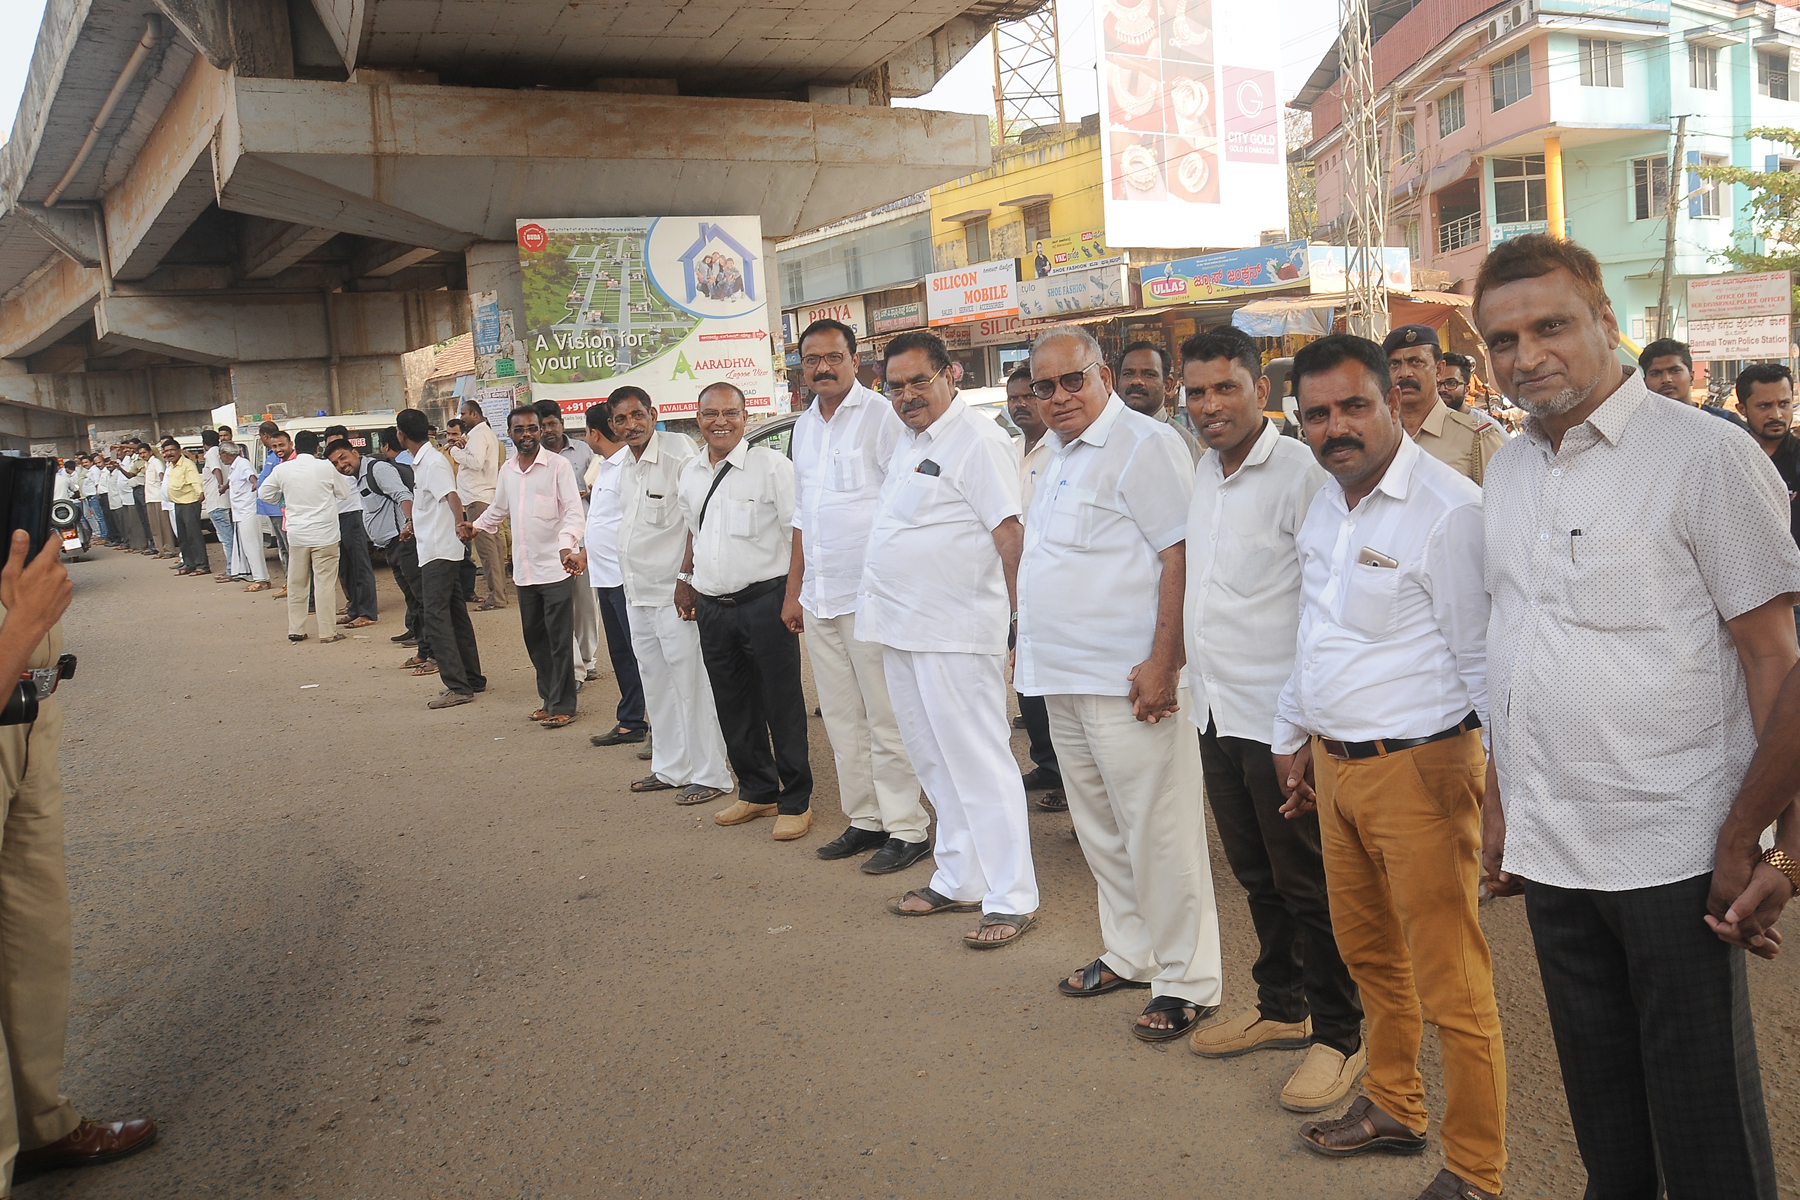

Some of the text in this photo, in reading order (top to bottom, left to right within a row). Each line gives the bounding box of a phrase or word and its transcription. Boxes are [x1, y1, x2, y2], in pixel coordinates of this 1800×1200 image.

[1228, 131, 1276, 145] CITY GOLD
[1229, 145, 1243, 153] GOLD
[1066, 264, 1087, 272] FASHION
[933, 271, 978, 292] SILICON
[1021, 283, 1036, 294] tylo
[1153, 279, 1186, 295] ULLAS
[964, 284, 1009, 305] MOBILE
[1047, 283, 1087, 297] SHOE FASHION
[808, 304, 851, 324] PRIYA
[535, 330, 646, 351] A Vision for
[1690, 335, 1787, 347] Bantwal Town Police Station
[477, 344, 501, 355] BVP
[536, 355, 581, 375] your
[586, 351, 616, 368] life
[694, 357, 756, 371] AARADHYA
[566, 402, 584, 412] +91
[662, 398, 768, 412] AVAILABL CENTS
